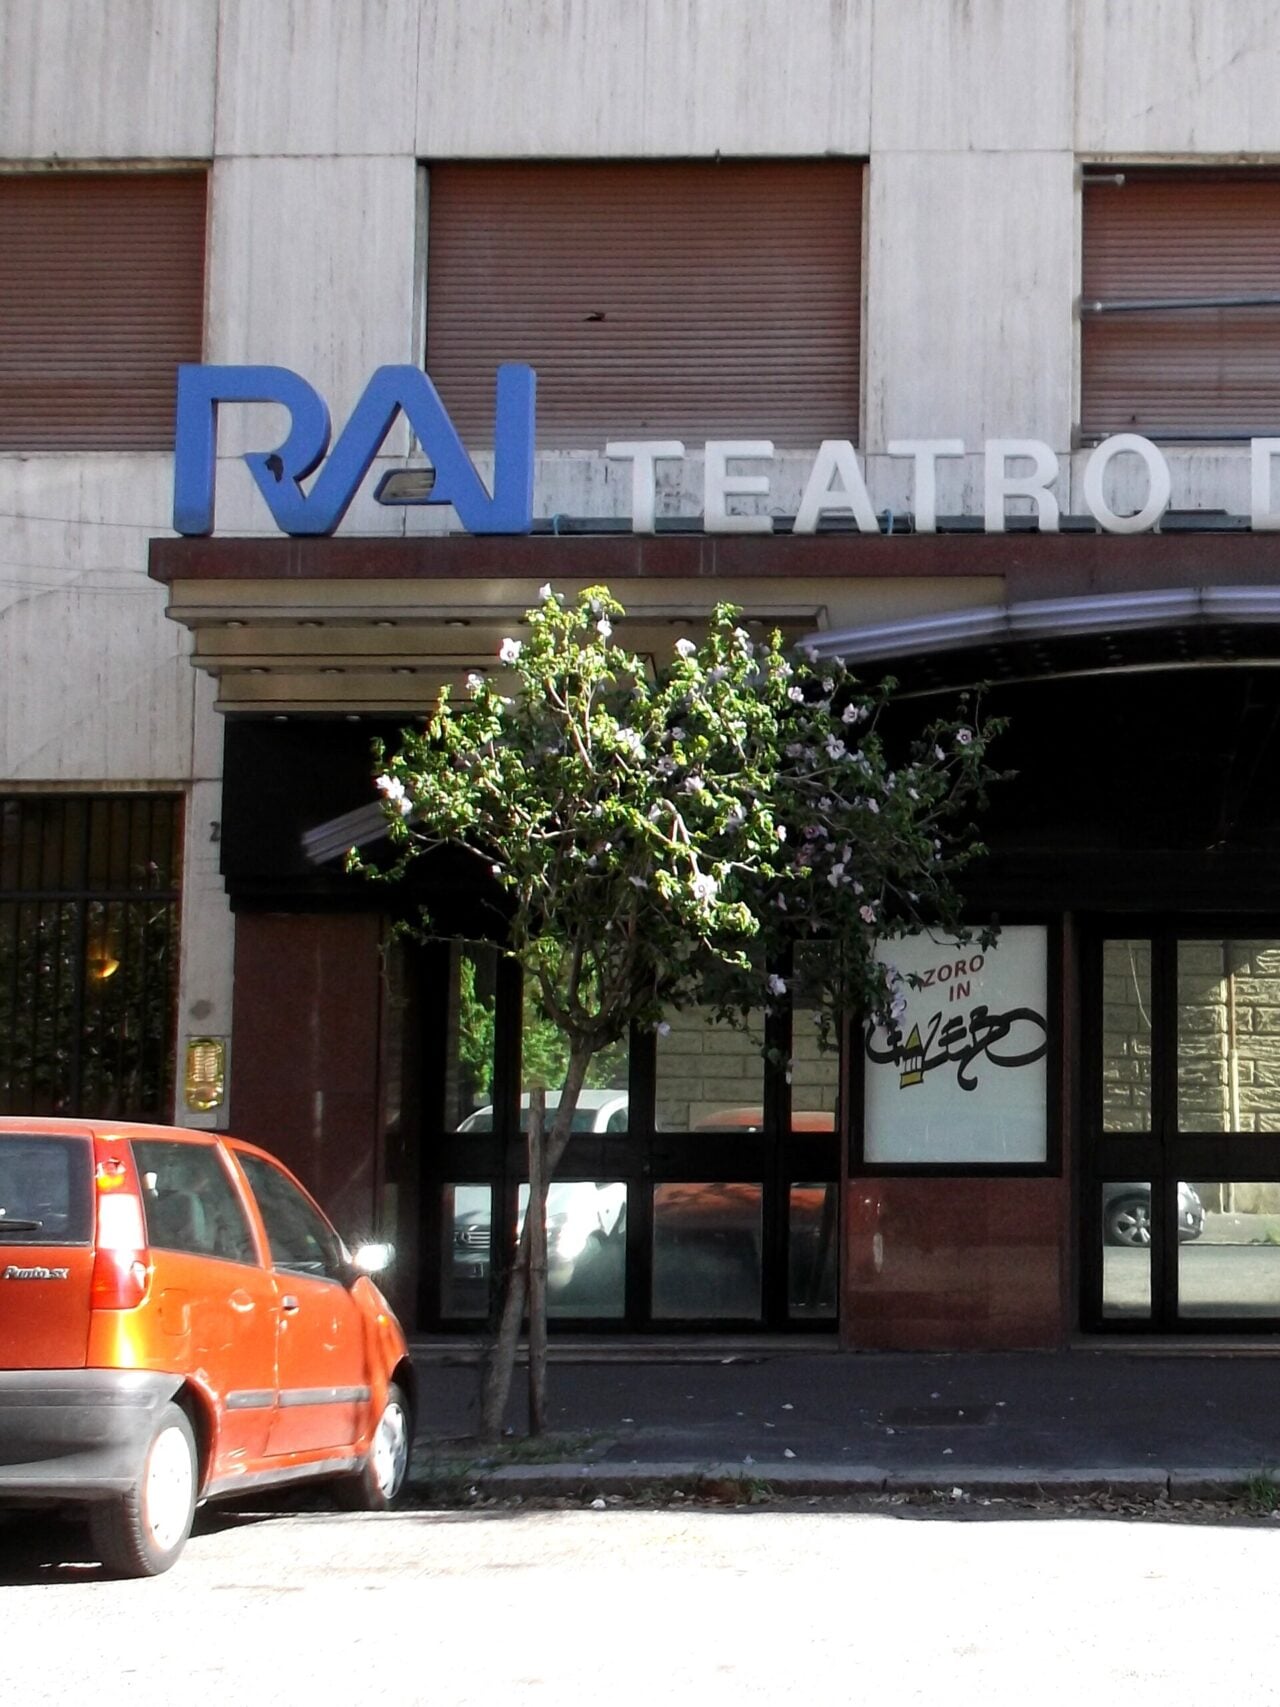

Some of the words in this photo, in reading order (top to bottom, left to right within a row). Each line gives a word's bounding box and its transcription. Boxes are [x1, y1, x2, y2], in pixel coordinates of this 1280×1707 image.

[172, 363, 537, 537] RAI
[605, 433, 1171, 534] TEATRO
[949, 980, 971, 1002] IN
